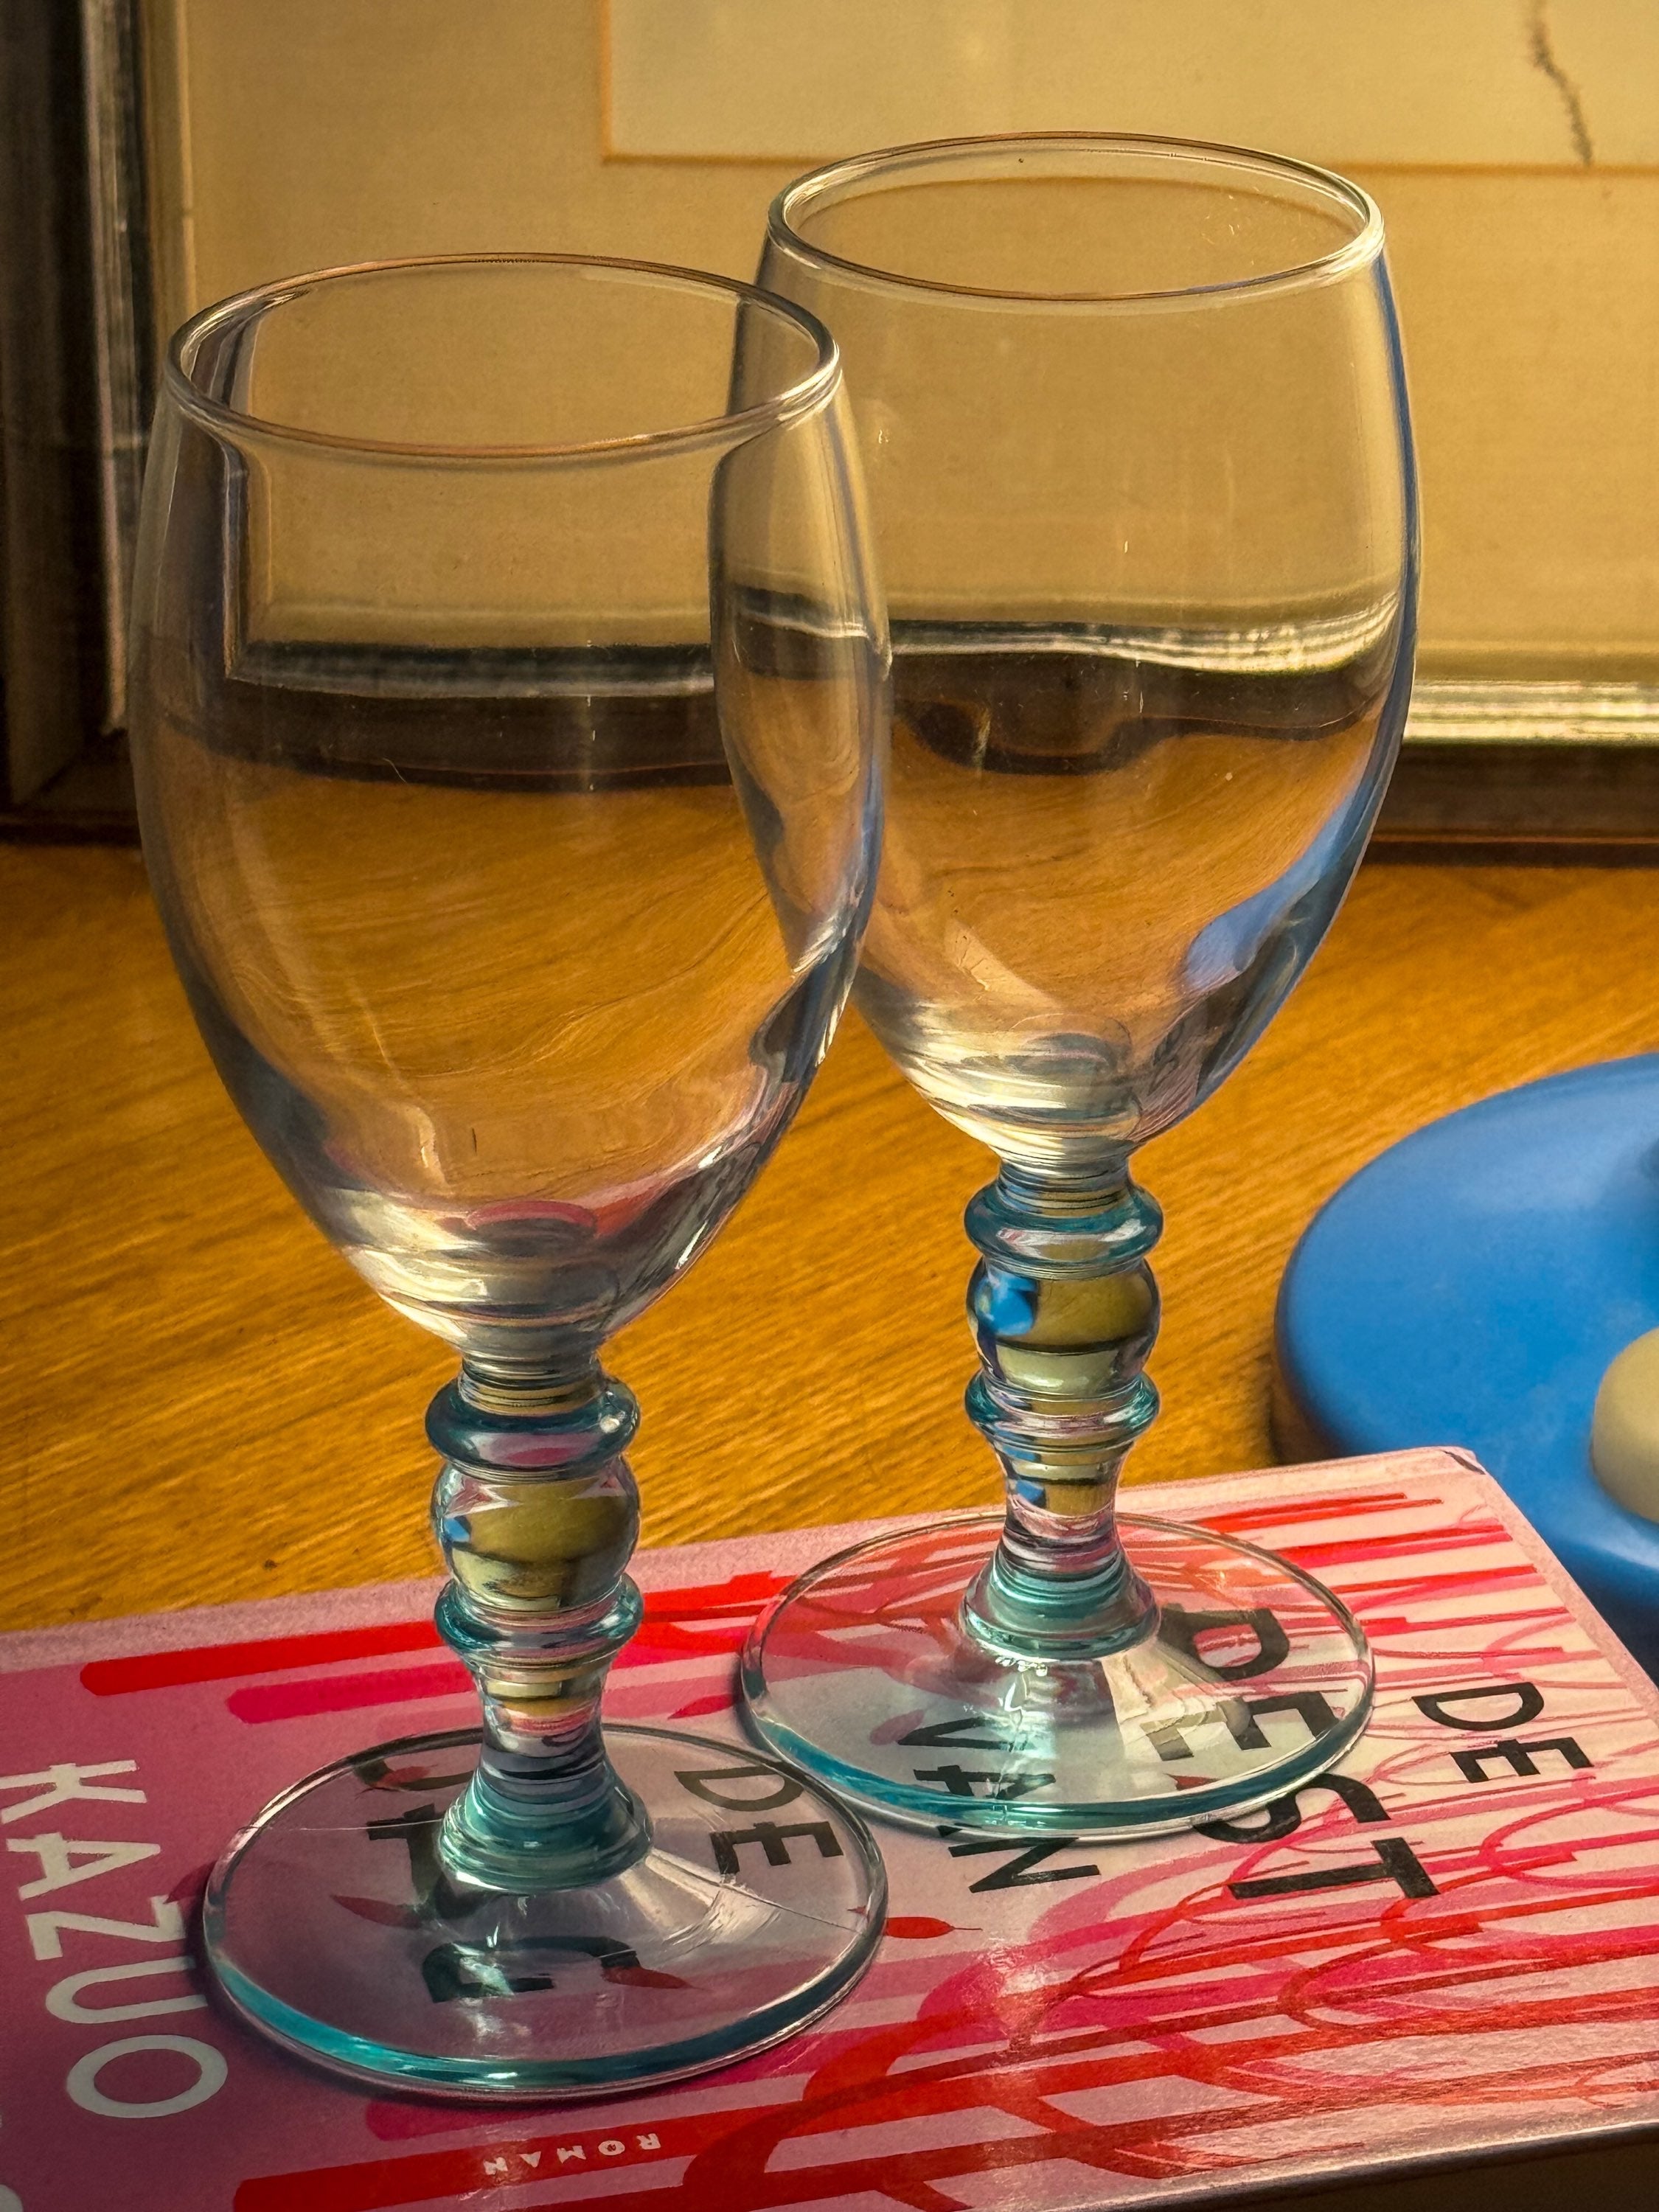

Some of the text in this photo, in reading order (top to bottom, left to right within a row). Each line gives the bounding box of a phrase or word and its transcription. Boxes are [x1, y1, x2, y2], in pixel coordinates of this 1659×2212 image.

[1411, 1680, 1594, 1783] DE
[674, 1762, 844, 1874] DE
[897, 1715, 1101, 1893] VAN
[0, 1760, 228, 2118] KAZUO
[482, 2133, 661, 2176] ROMAN
